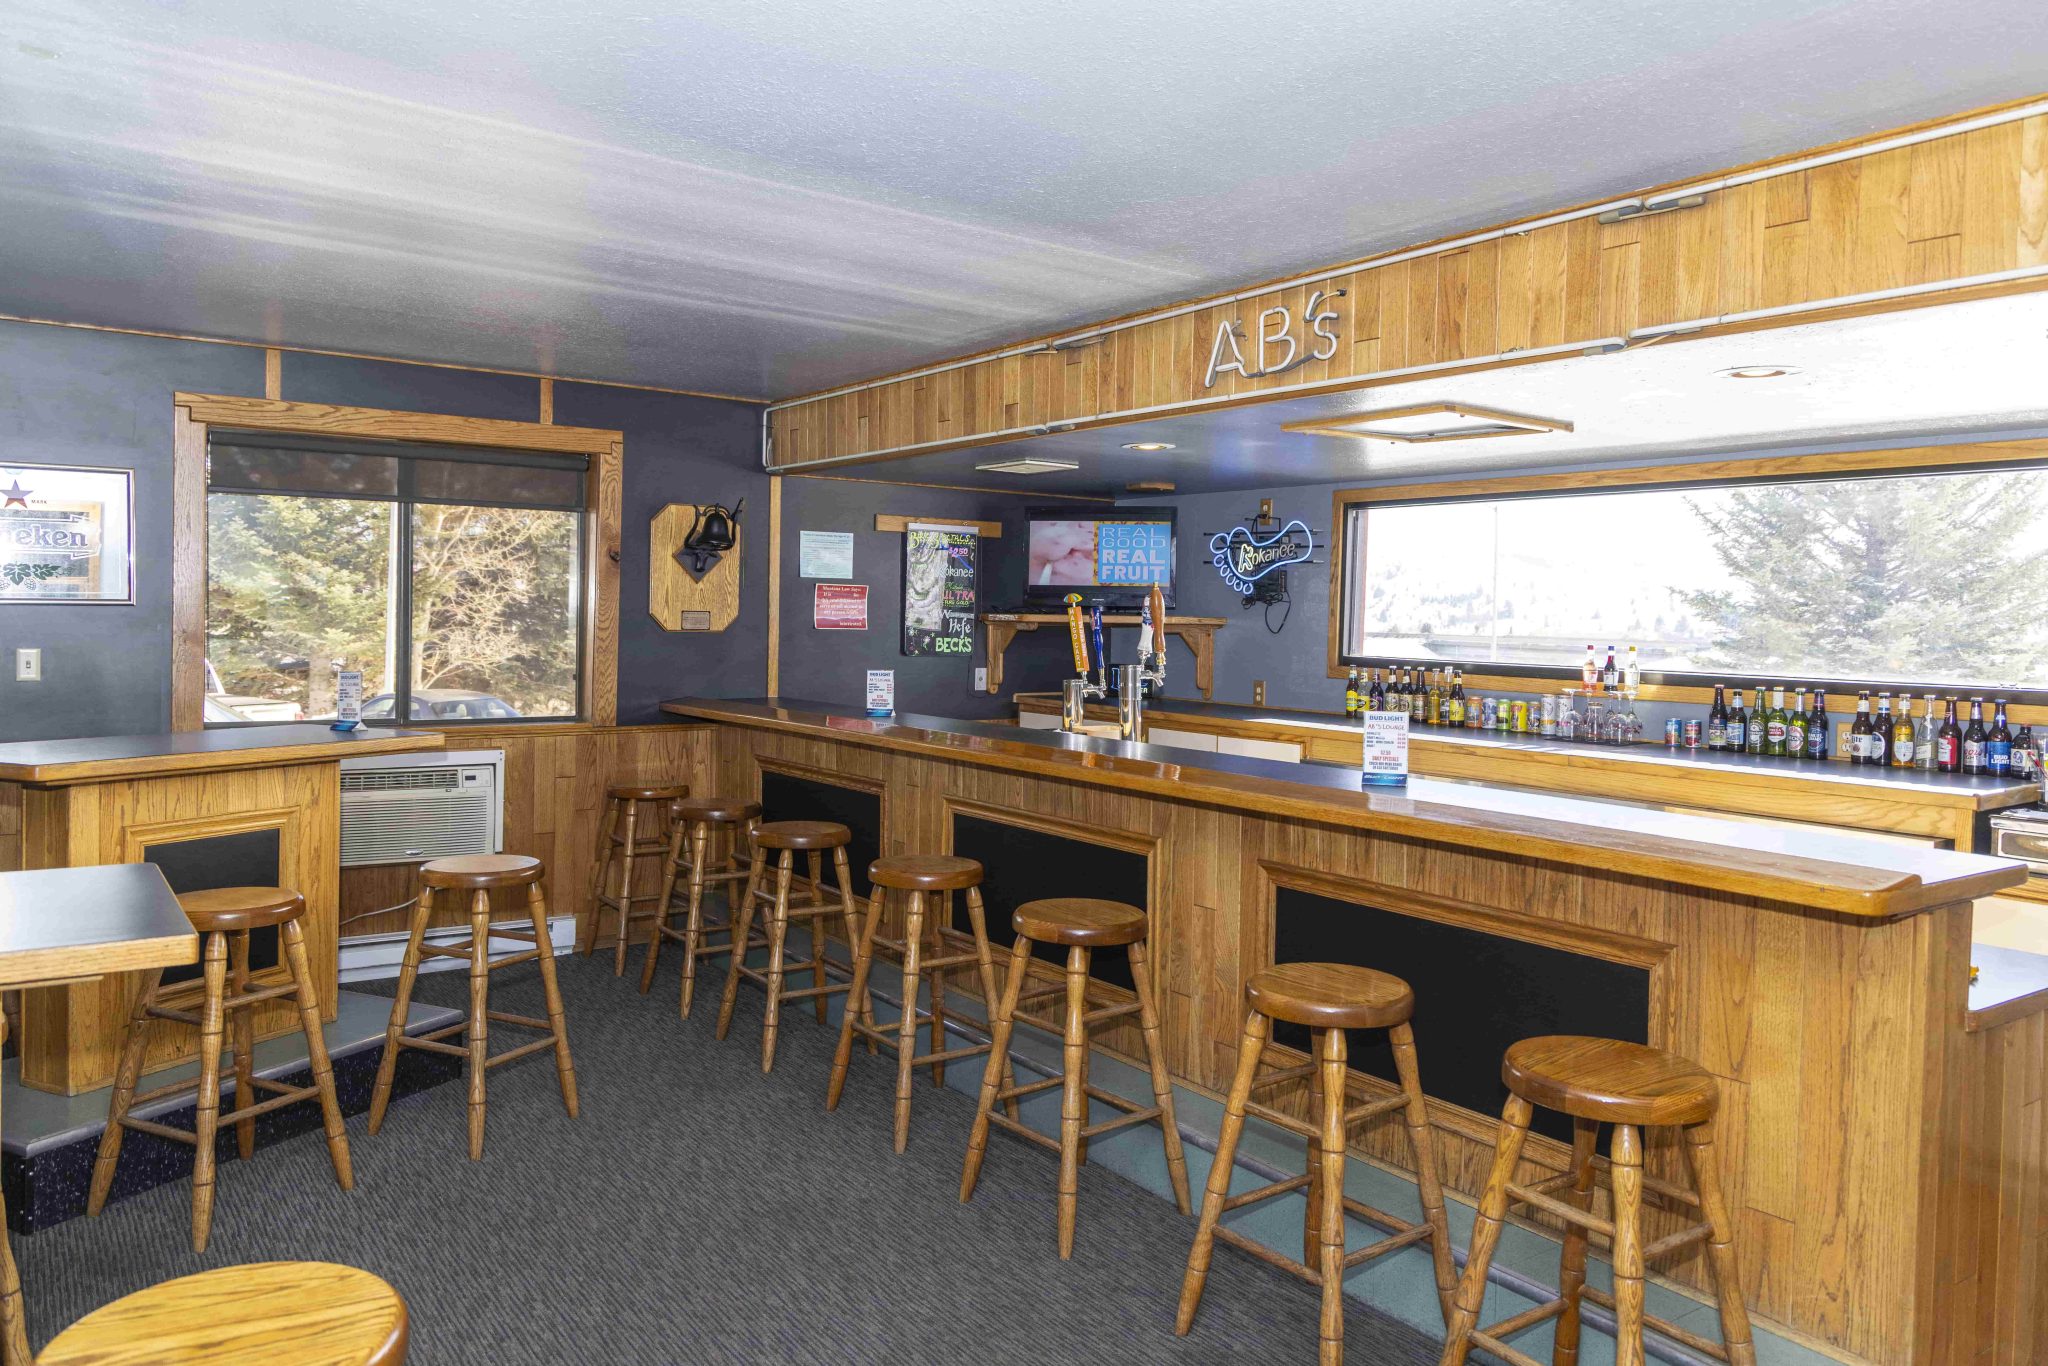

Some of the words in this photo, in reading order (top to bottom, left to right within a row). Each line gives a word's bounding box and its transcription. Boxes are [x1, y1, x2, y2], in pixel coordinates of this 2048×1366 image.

[1102, 527, 1165, 538] REAL
[1102, 538, 1166, 548] GOOD
[1102, 549, 1166, 564] REAL
[1238, 543, 1295, 573] Kokanee
[1102, 565, 1166, 581] FRUIT
[943, 591, 975, 602] ULTRA
[948, 618, 972, 638] Hefe
[935, 637, 972, 653] BECK'S
[1069, 608, 1078, 640] MANGO
[1074, 642, 1082, 668] CART
